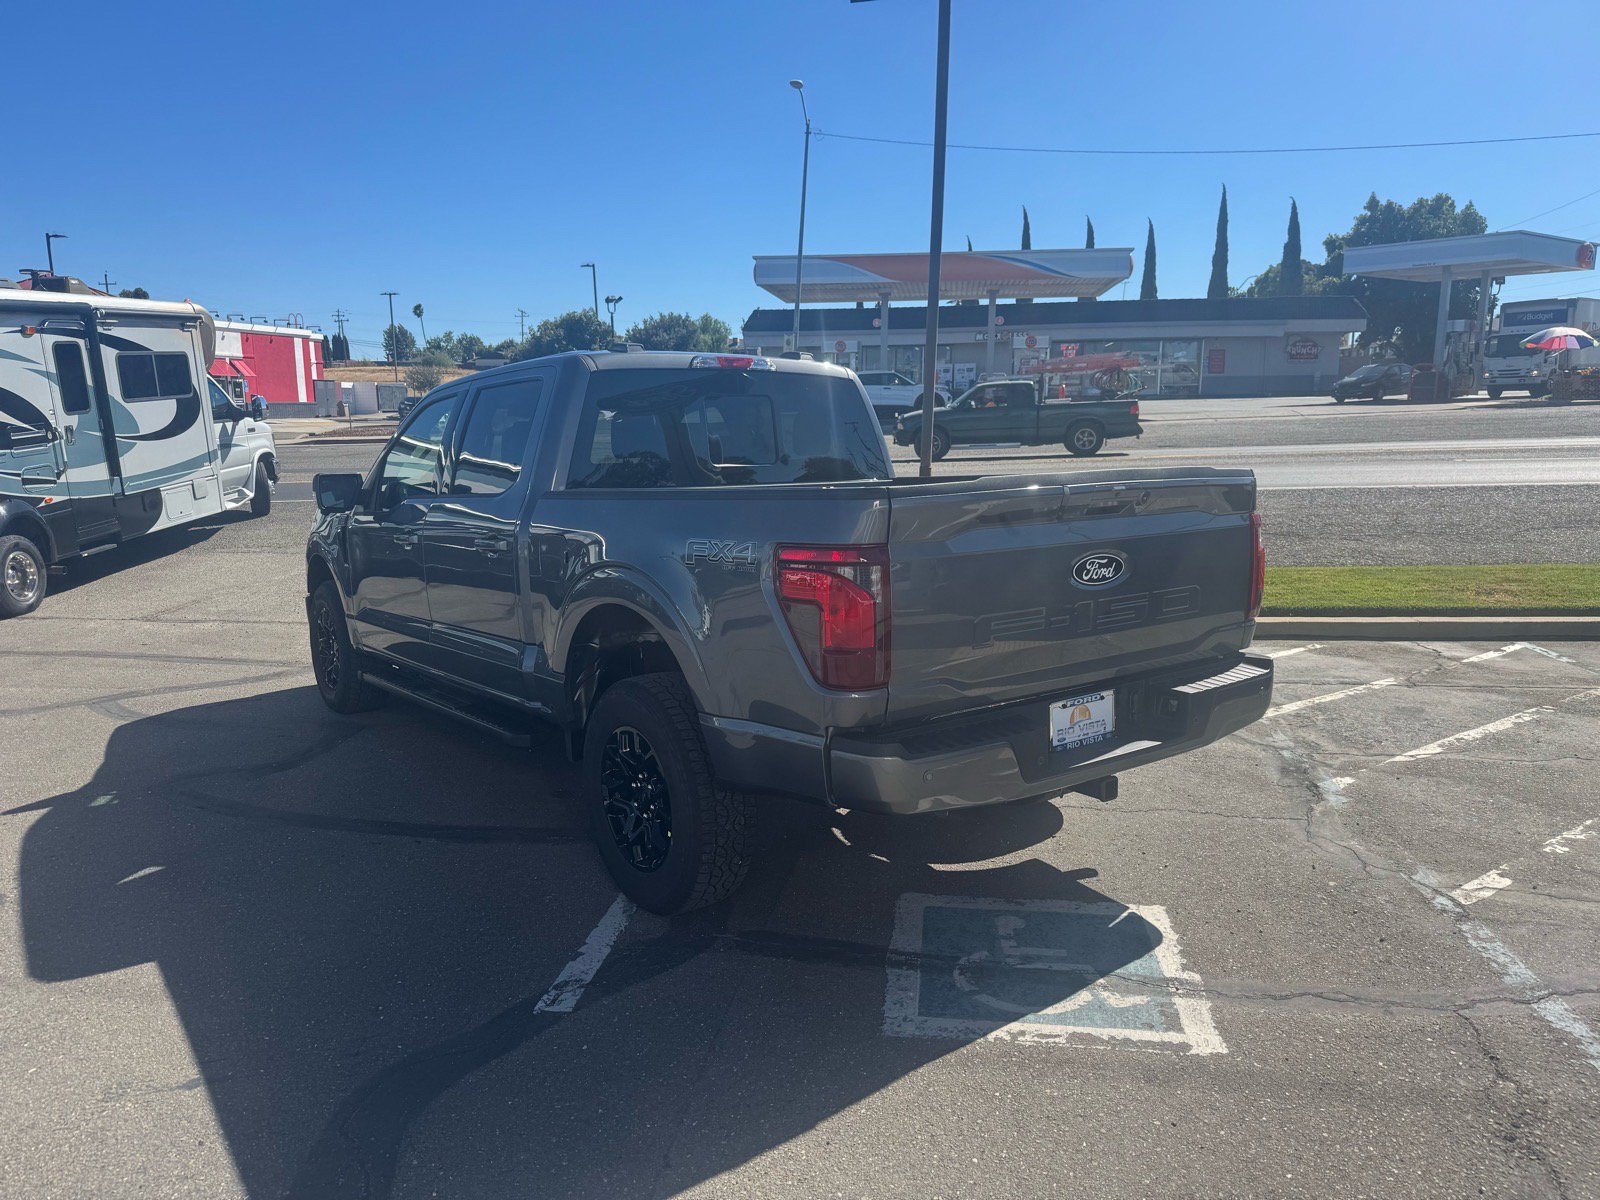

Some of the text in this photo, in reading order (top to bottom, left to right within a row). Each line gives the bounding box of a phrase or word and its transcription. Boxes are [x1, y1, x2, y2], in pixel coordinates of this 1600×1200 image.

[1526, 312, 1553, 321] Budget
[685, 539, 757, 566] FX4
[1082, 558, 1116, 581] Ford
[972, 584, 1200, 650] F-150
[1067, 694, 1100, 707] FORD
[1057, 726, 1074, 737] RIO
[1078, 719, 1106, 731] VISTA
[1067, 735, 1103, 749] RIO VISTA
